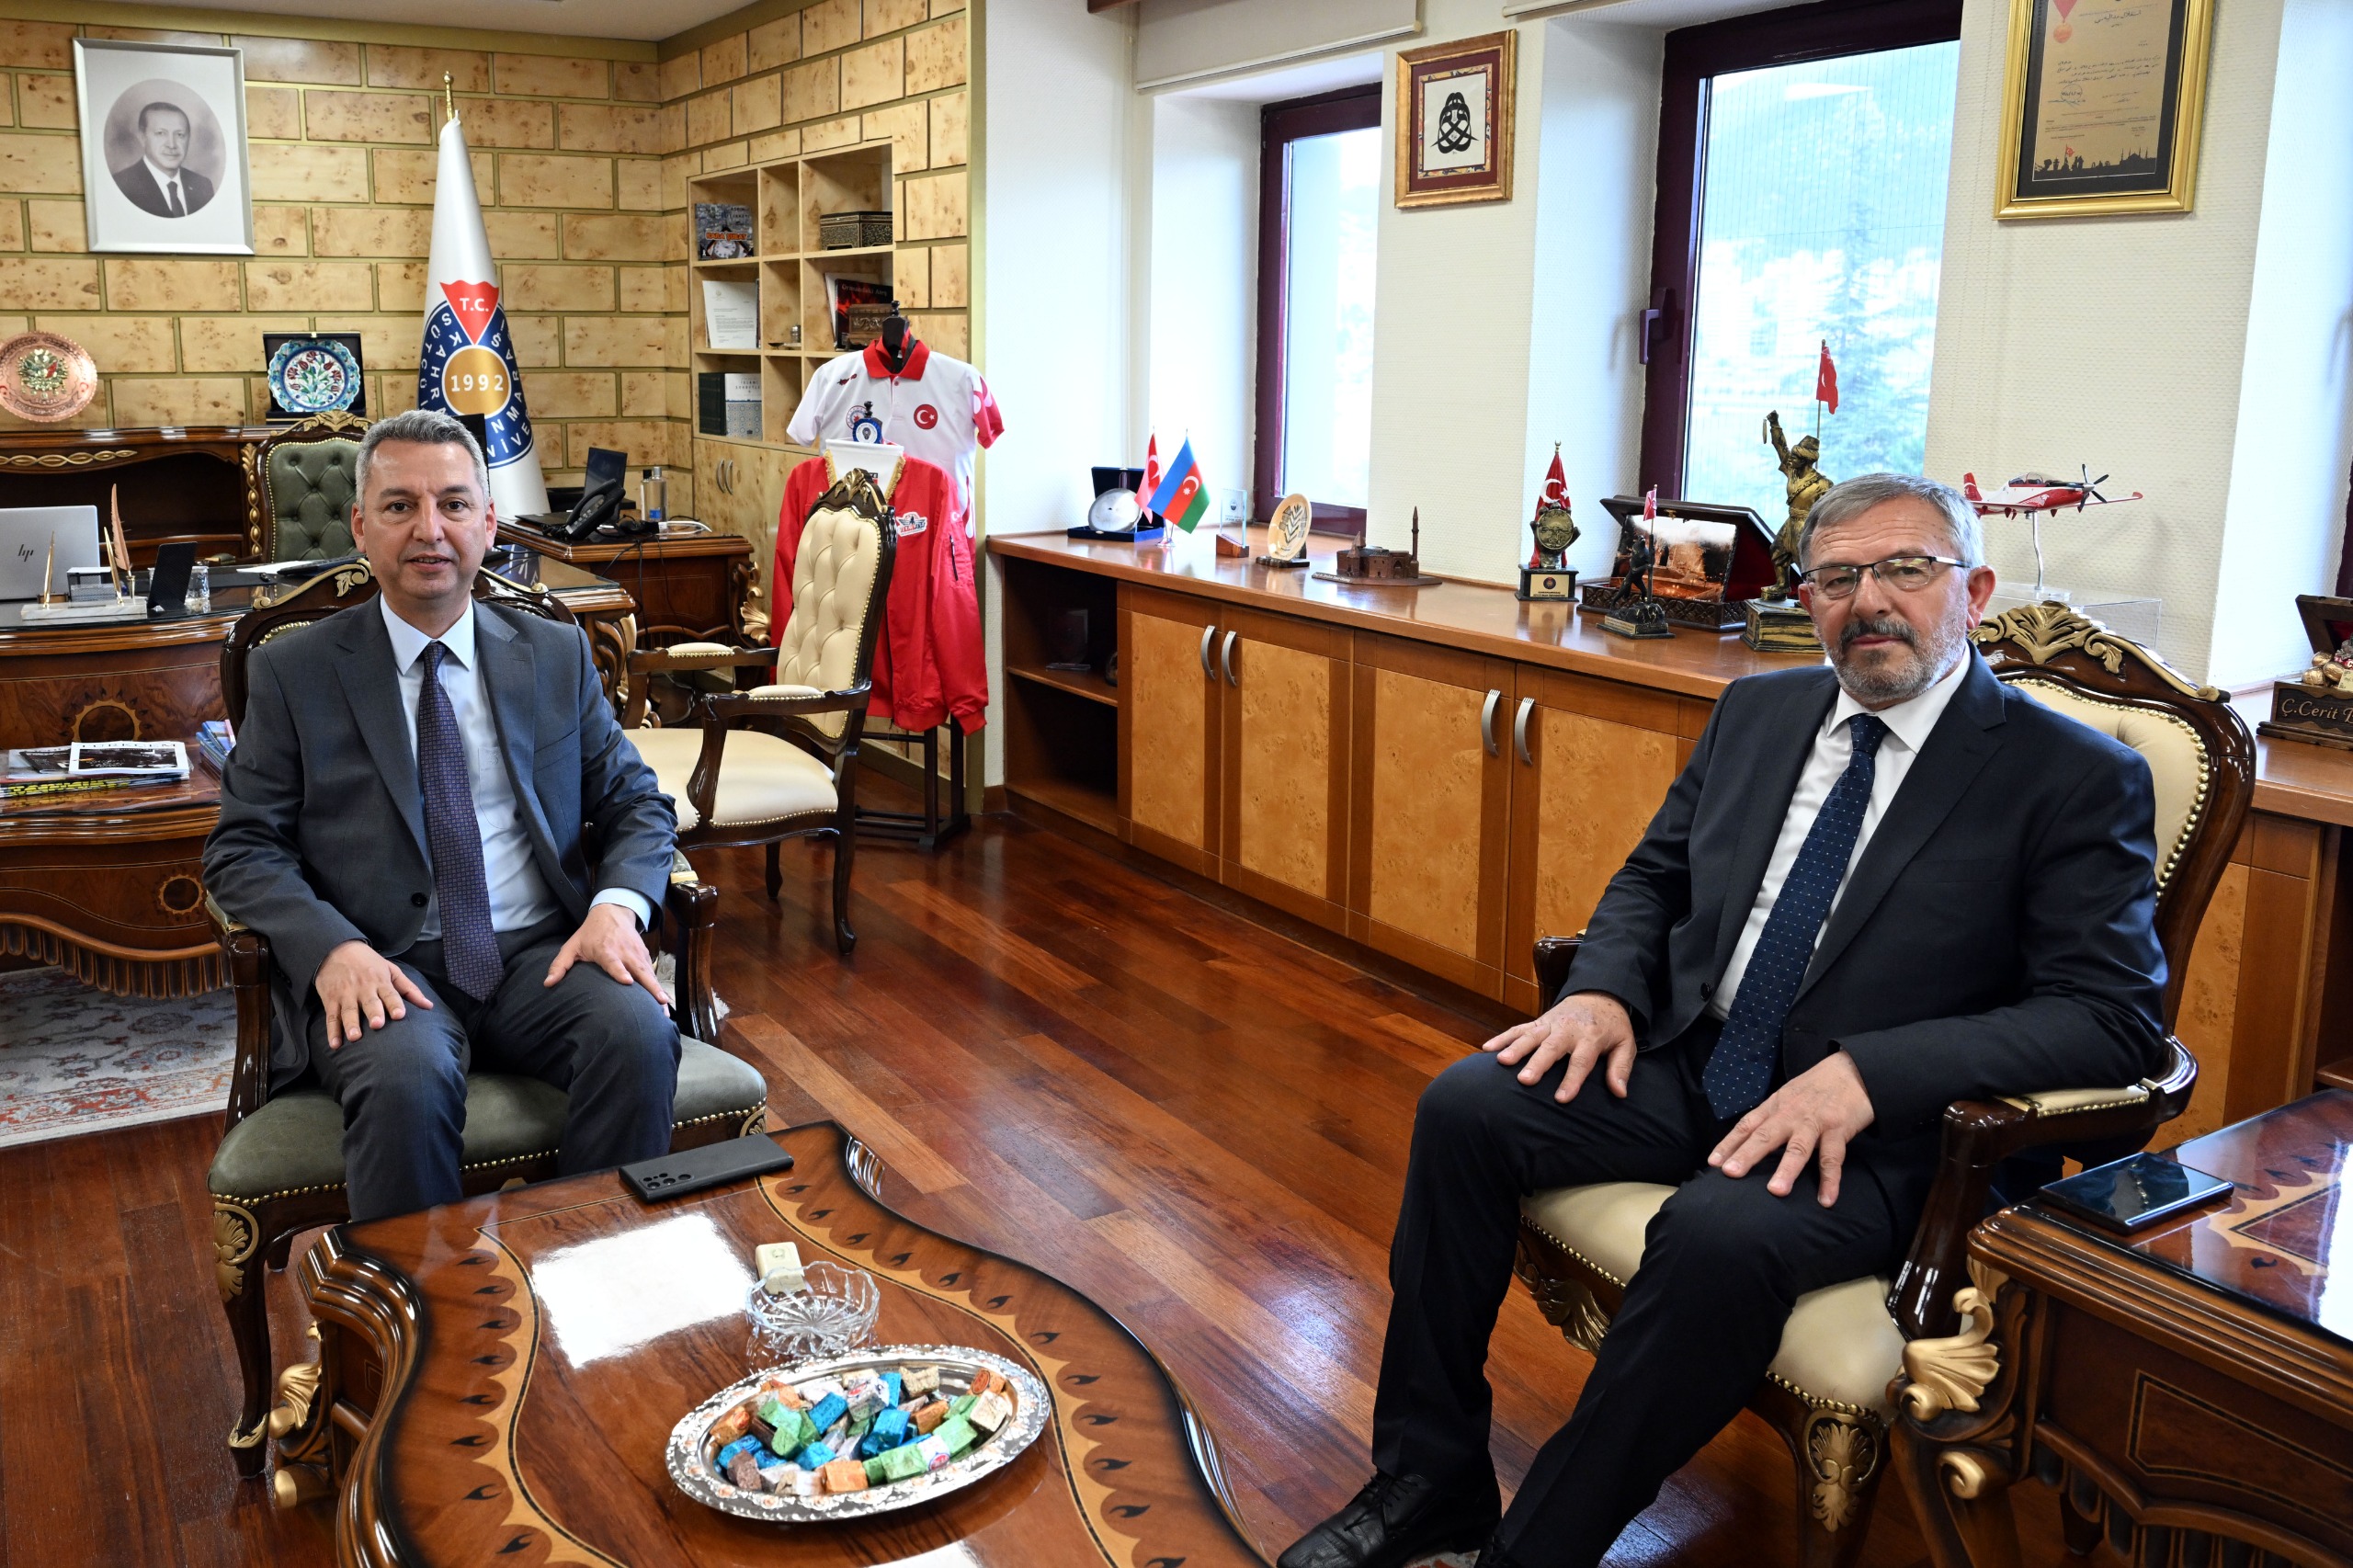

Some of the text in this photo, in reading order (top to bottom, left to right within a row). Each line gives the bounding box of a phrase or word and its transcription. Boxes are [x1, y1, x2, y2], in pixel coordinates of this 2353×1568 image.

[460, 298, 490, 312] T.C.
[451, 375, 504, 392] 1992
[17, 543, 34, 562] hp
